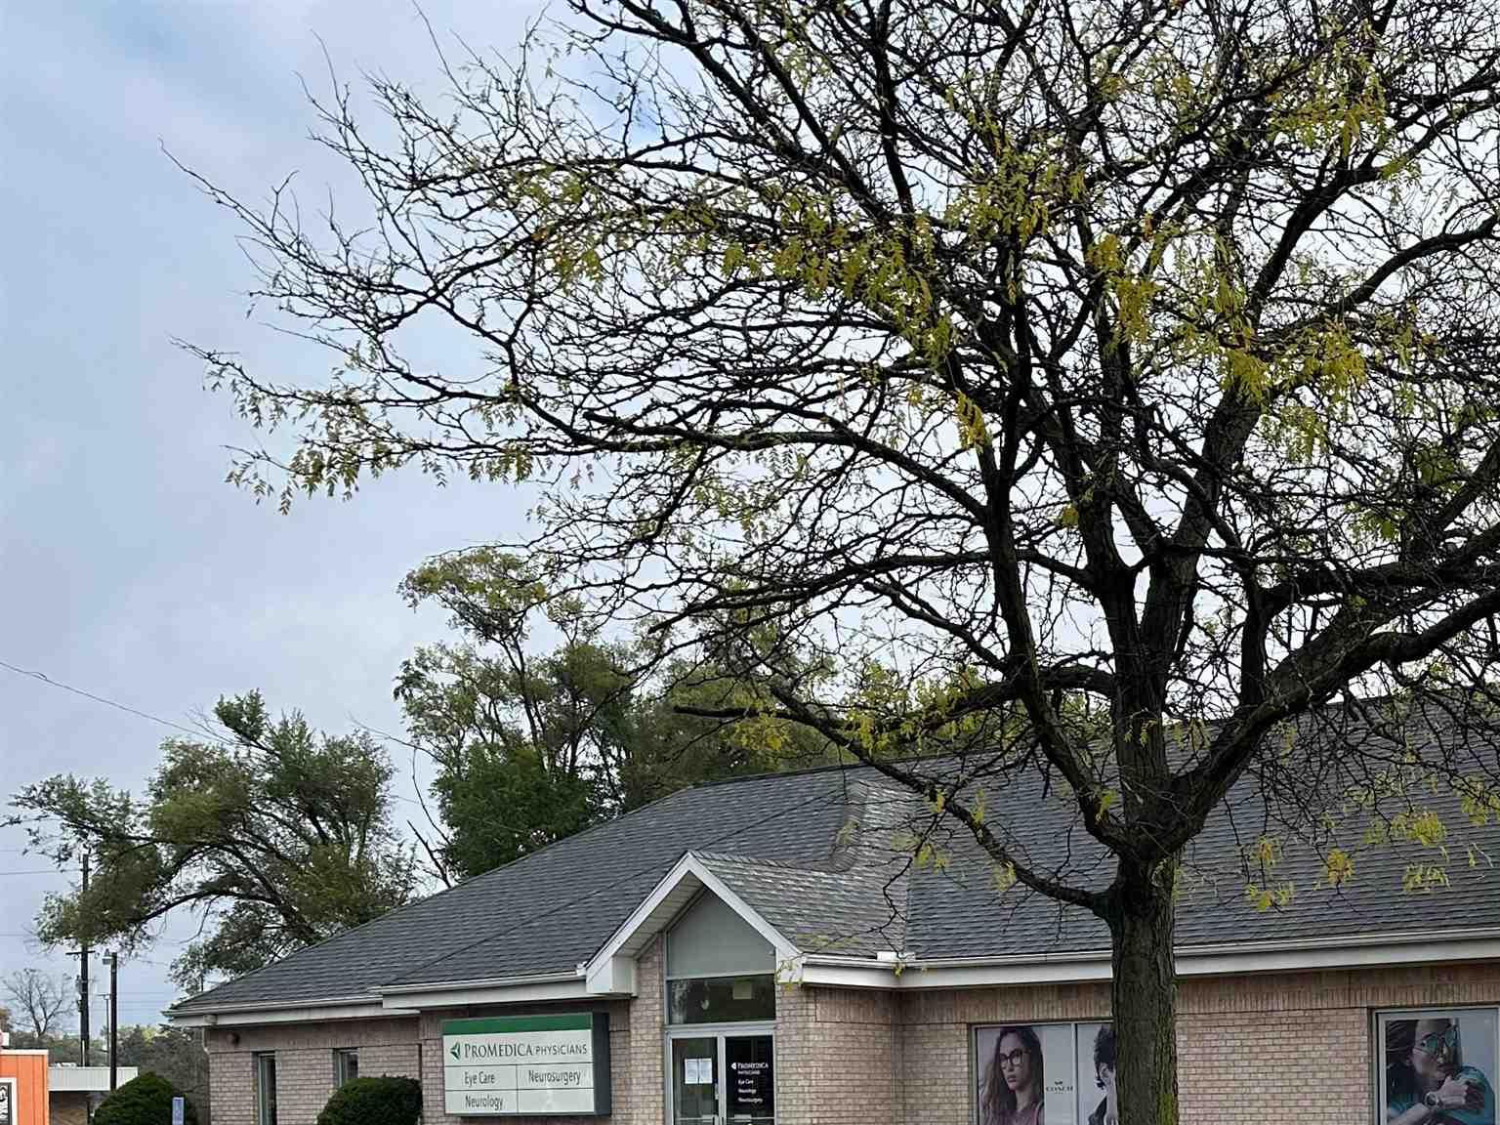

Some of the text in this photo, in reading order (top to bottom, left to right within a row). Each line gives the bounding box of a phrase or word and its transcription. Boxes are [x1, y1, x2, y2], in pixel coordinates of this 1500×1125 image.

[535, 1044, 587, 1055] PHYSICIANS
[464, 1071, 496, 1087] Eye Care
[528, 1069, 582, 1086] Neurosurgery
[465, 1095, 504, 1110] Neurology
